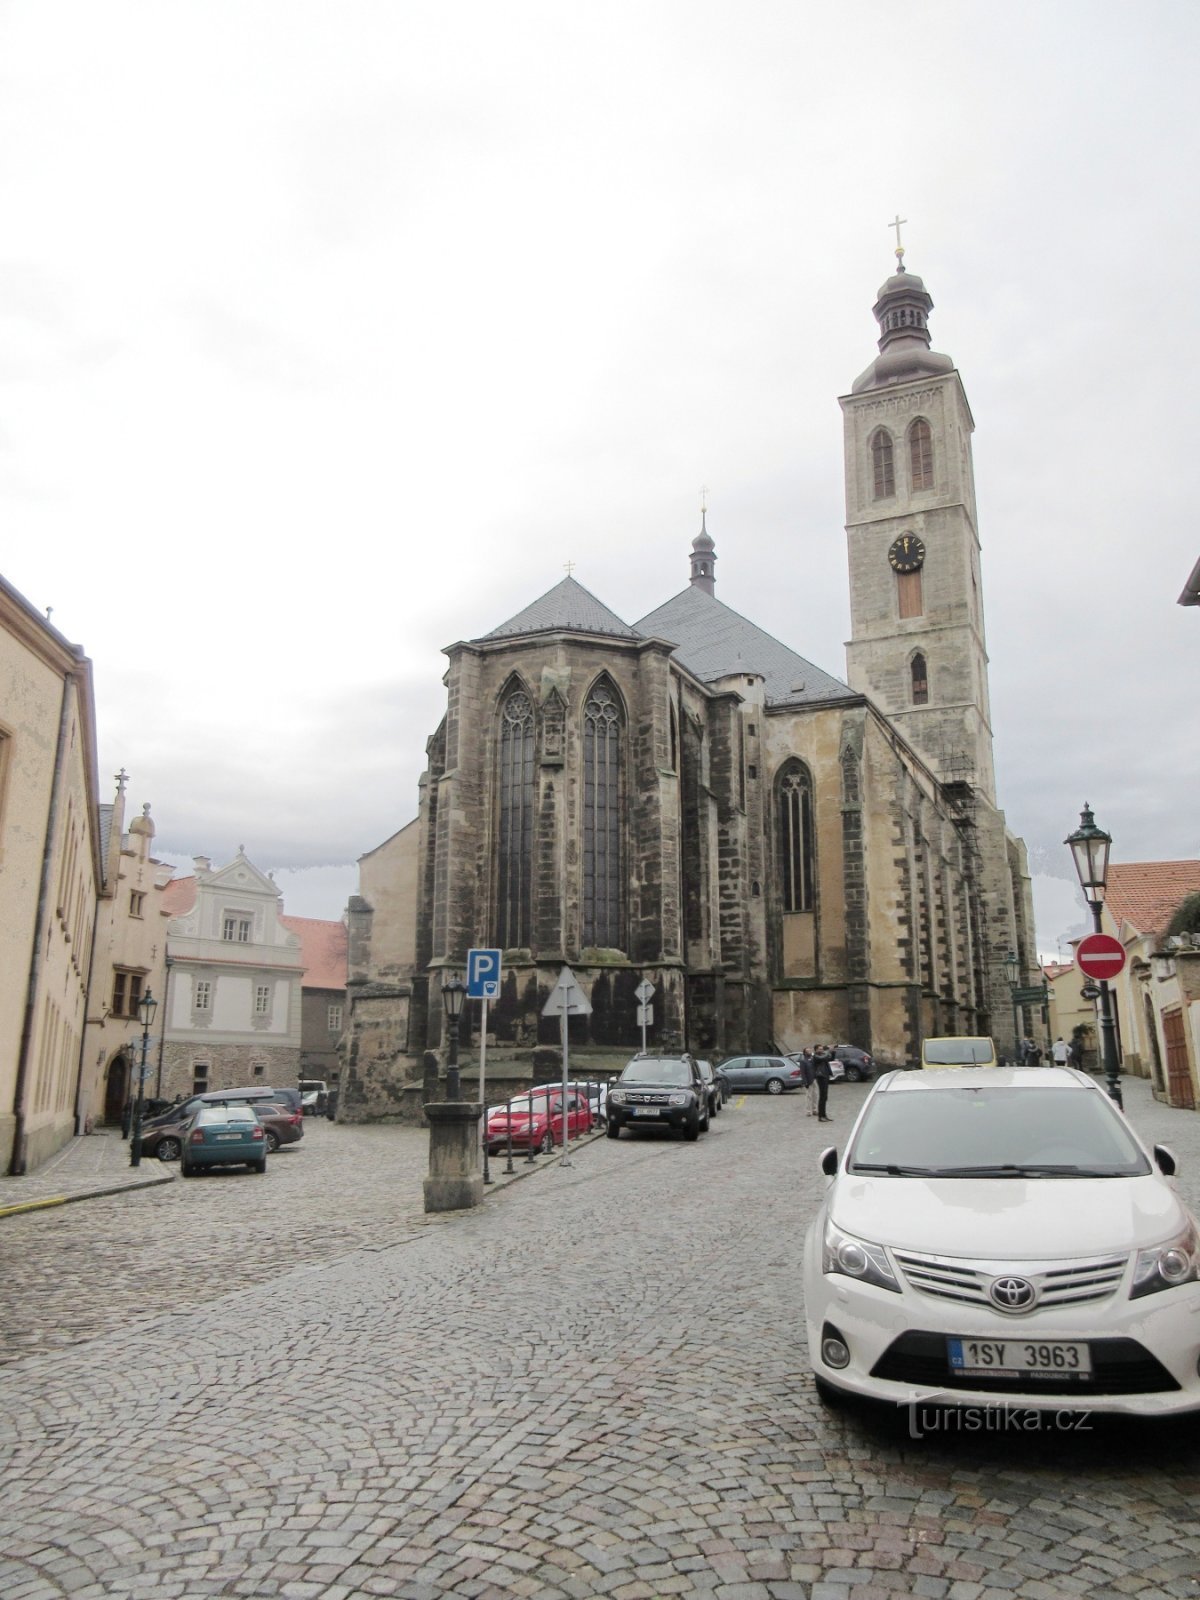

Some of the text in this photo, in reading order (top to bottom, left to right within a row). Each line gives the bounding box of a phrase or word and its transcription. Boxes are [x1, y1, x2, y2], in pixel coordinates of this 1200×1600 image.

[474, 955, 494, 983] P
[968, 1343, 1080, 1368] 1SY 3963
